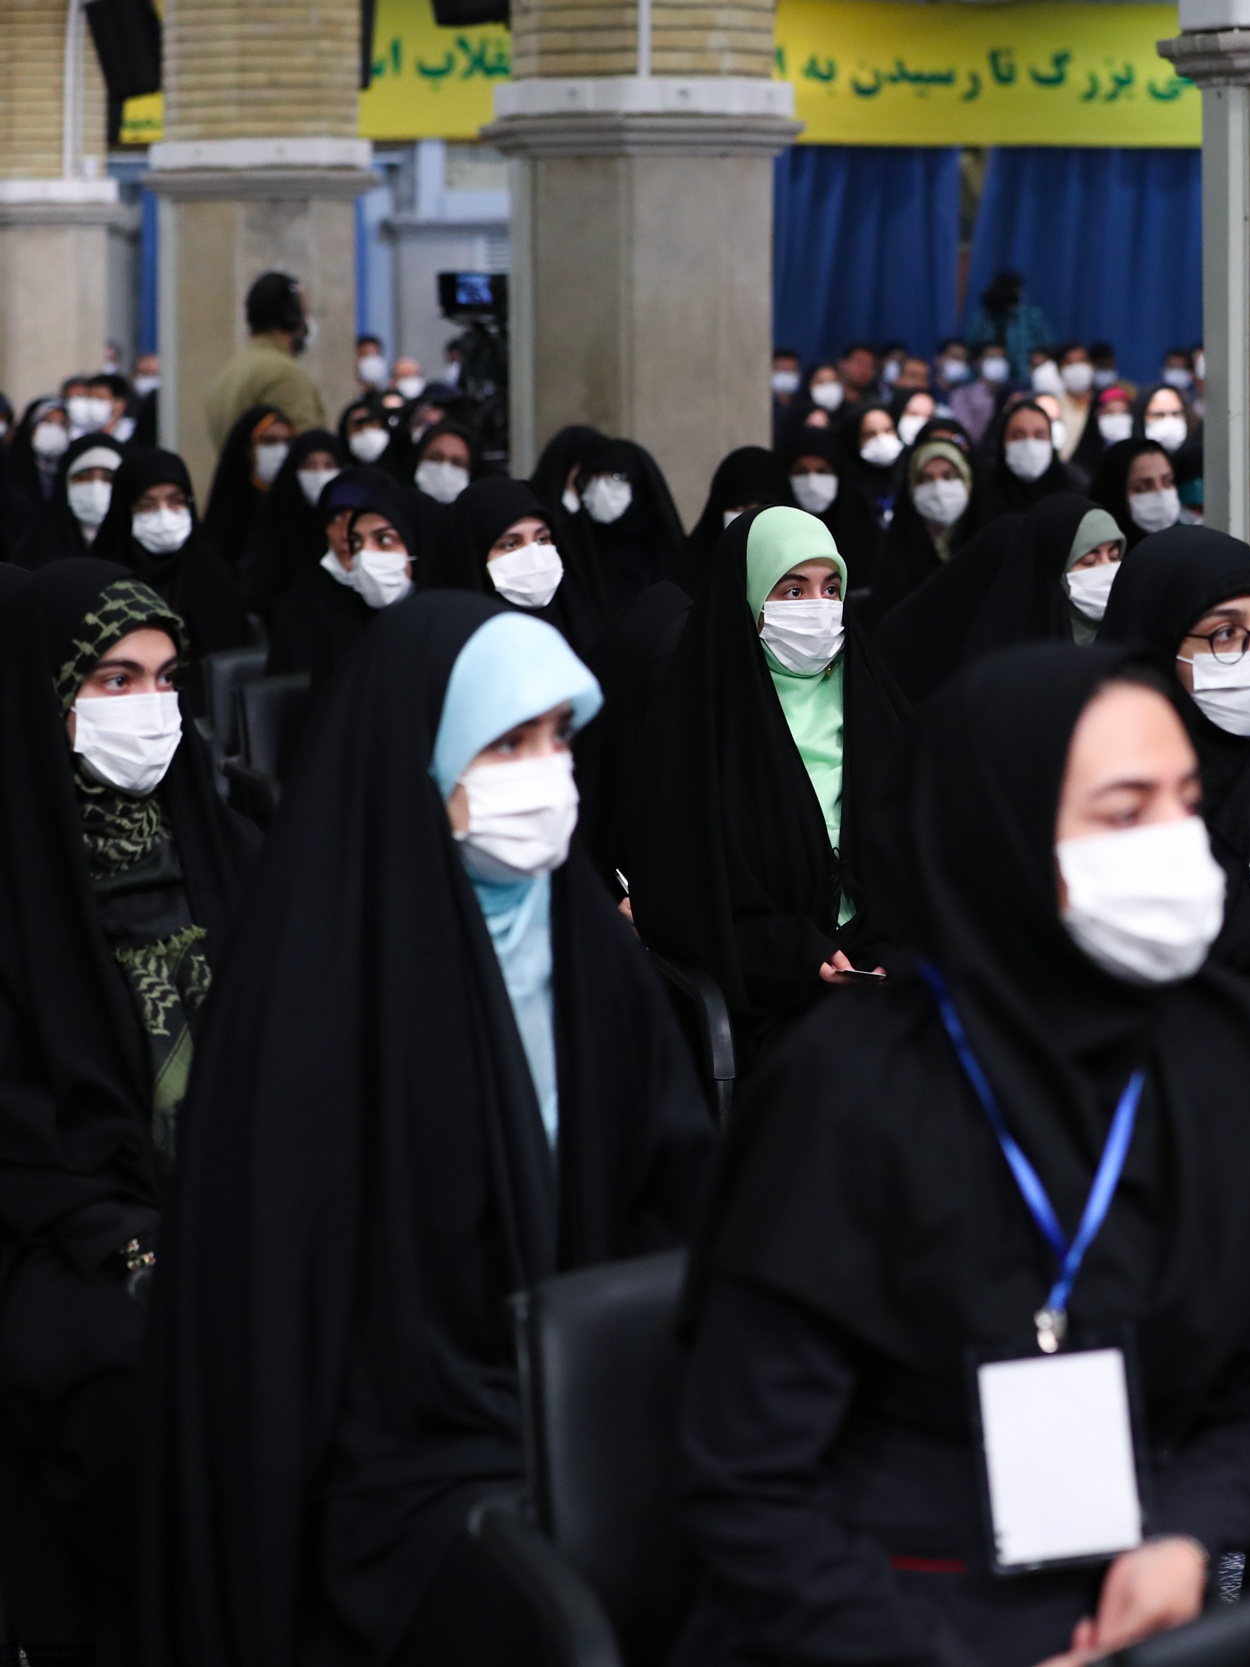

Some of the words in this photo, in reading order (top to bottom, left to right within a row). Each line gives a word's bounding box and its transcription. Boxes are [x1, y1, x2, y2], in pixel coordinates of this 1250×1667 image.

[801, 52, 836, 98] به
[848, 56, 983, 102] رسیدن
[988, 46, 1018, 85] تا
[1027, 48, 1135, 103] بزرگ
